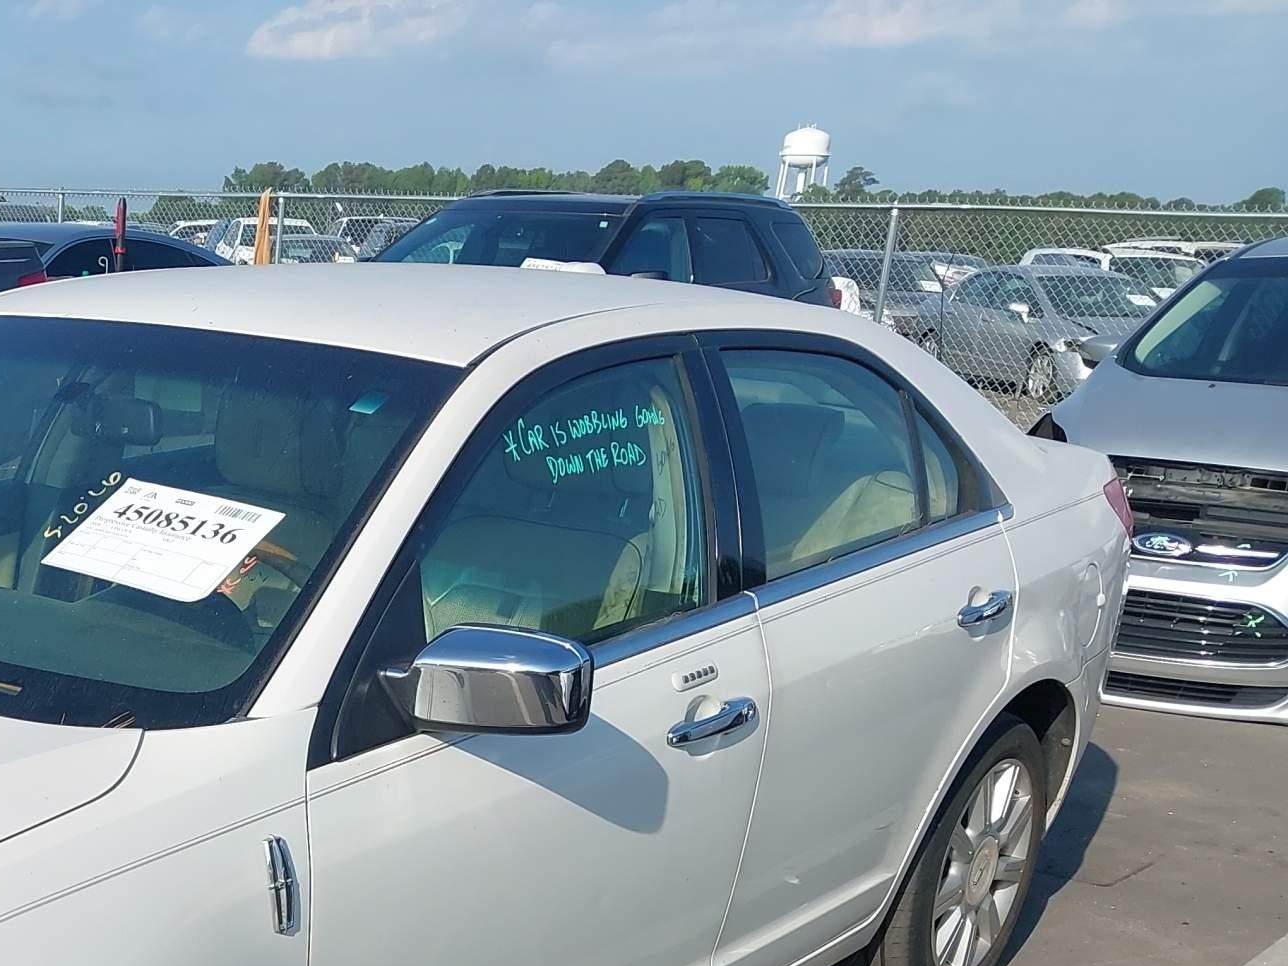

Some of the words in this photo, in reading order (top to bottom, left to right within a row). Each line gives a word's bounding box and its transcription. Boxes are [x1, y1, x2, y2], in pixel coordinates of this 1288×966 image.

[517, 417, 550, 455] CAR
[550, 420, 567, 448] IS
[567, 410, 628, 440] WOBBLING
[545, 454, 584, 484] DOWN
[585, 448, 609, 473] THE
[610, 441, 646, 467] ROAD
[113, 503, 247, 544] 45085136
